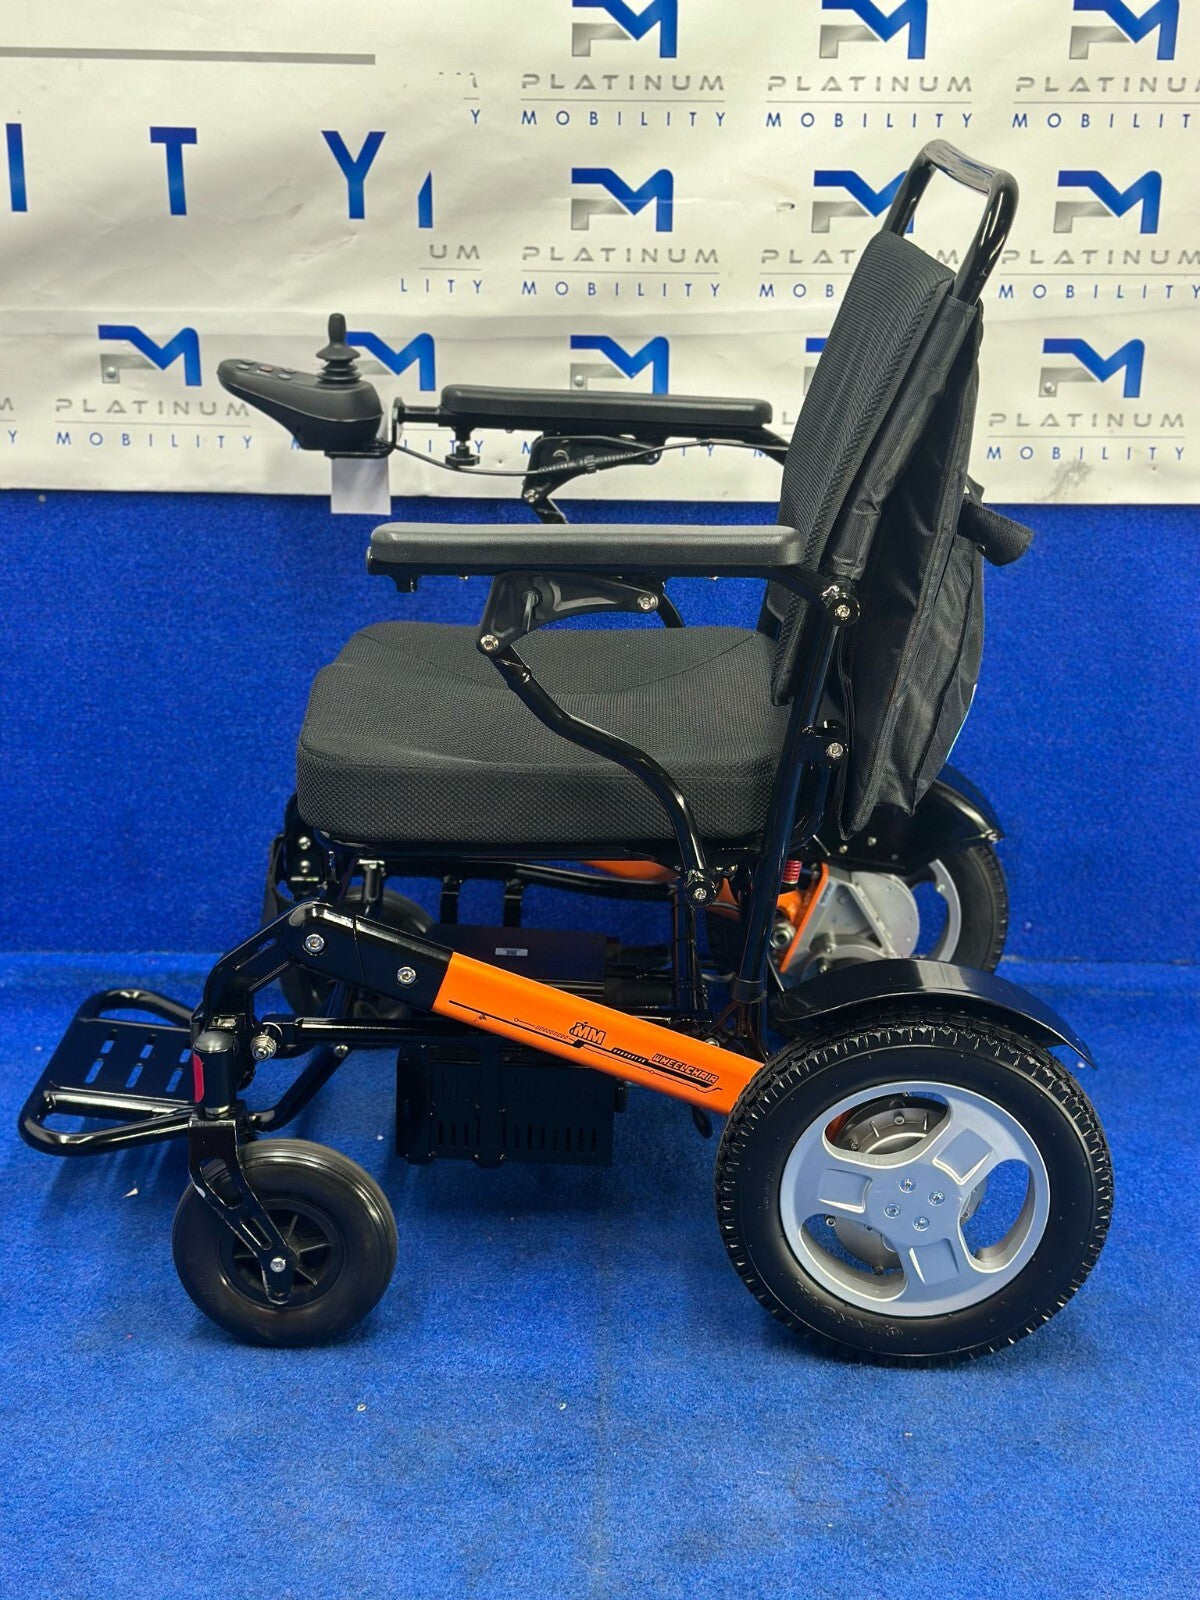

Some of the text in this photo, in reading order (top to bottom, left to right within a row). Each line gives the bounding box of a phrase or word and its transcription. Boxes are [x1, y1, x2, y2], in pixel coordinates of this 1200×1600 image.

[521, 74, 725, 91] PLATINUM
[767, 76, 972, 93] PLATINUM
[1016, 77, 1200, 93] PLATINU
[521, 110, 726, 127] MOBILITY
[766, 112, 973, 129] MOBILITY
[522, 246, 719, 264] PLATINUM
[522, 281, 720, 297] MOBILITY
[56, 398, 250, 416] PLATINUM
[988, 413, 1185, 428] PLATINUM
[56, 431, 252, 449] MOBILITY
[986, 446, 1185, 460] MOBILITY
[651, 1052, 720, 1086] WHEELCHAIR
